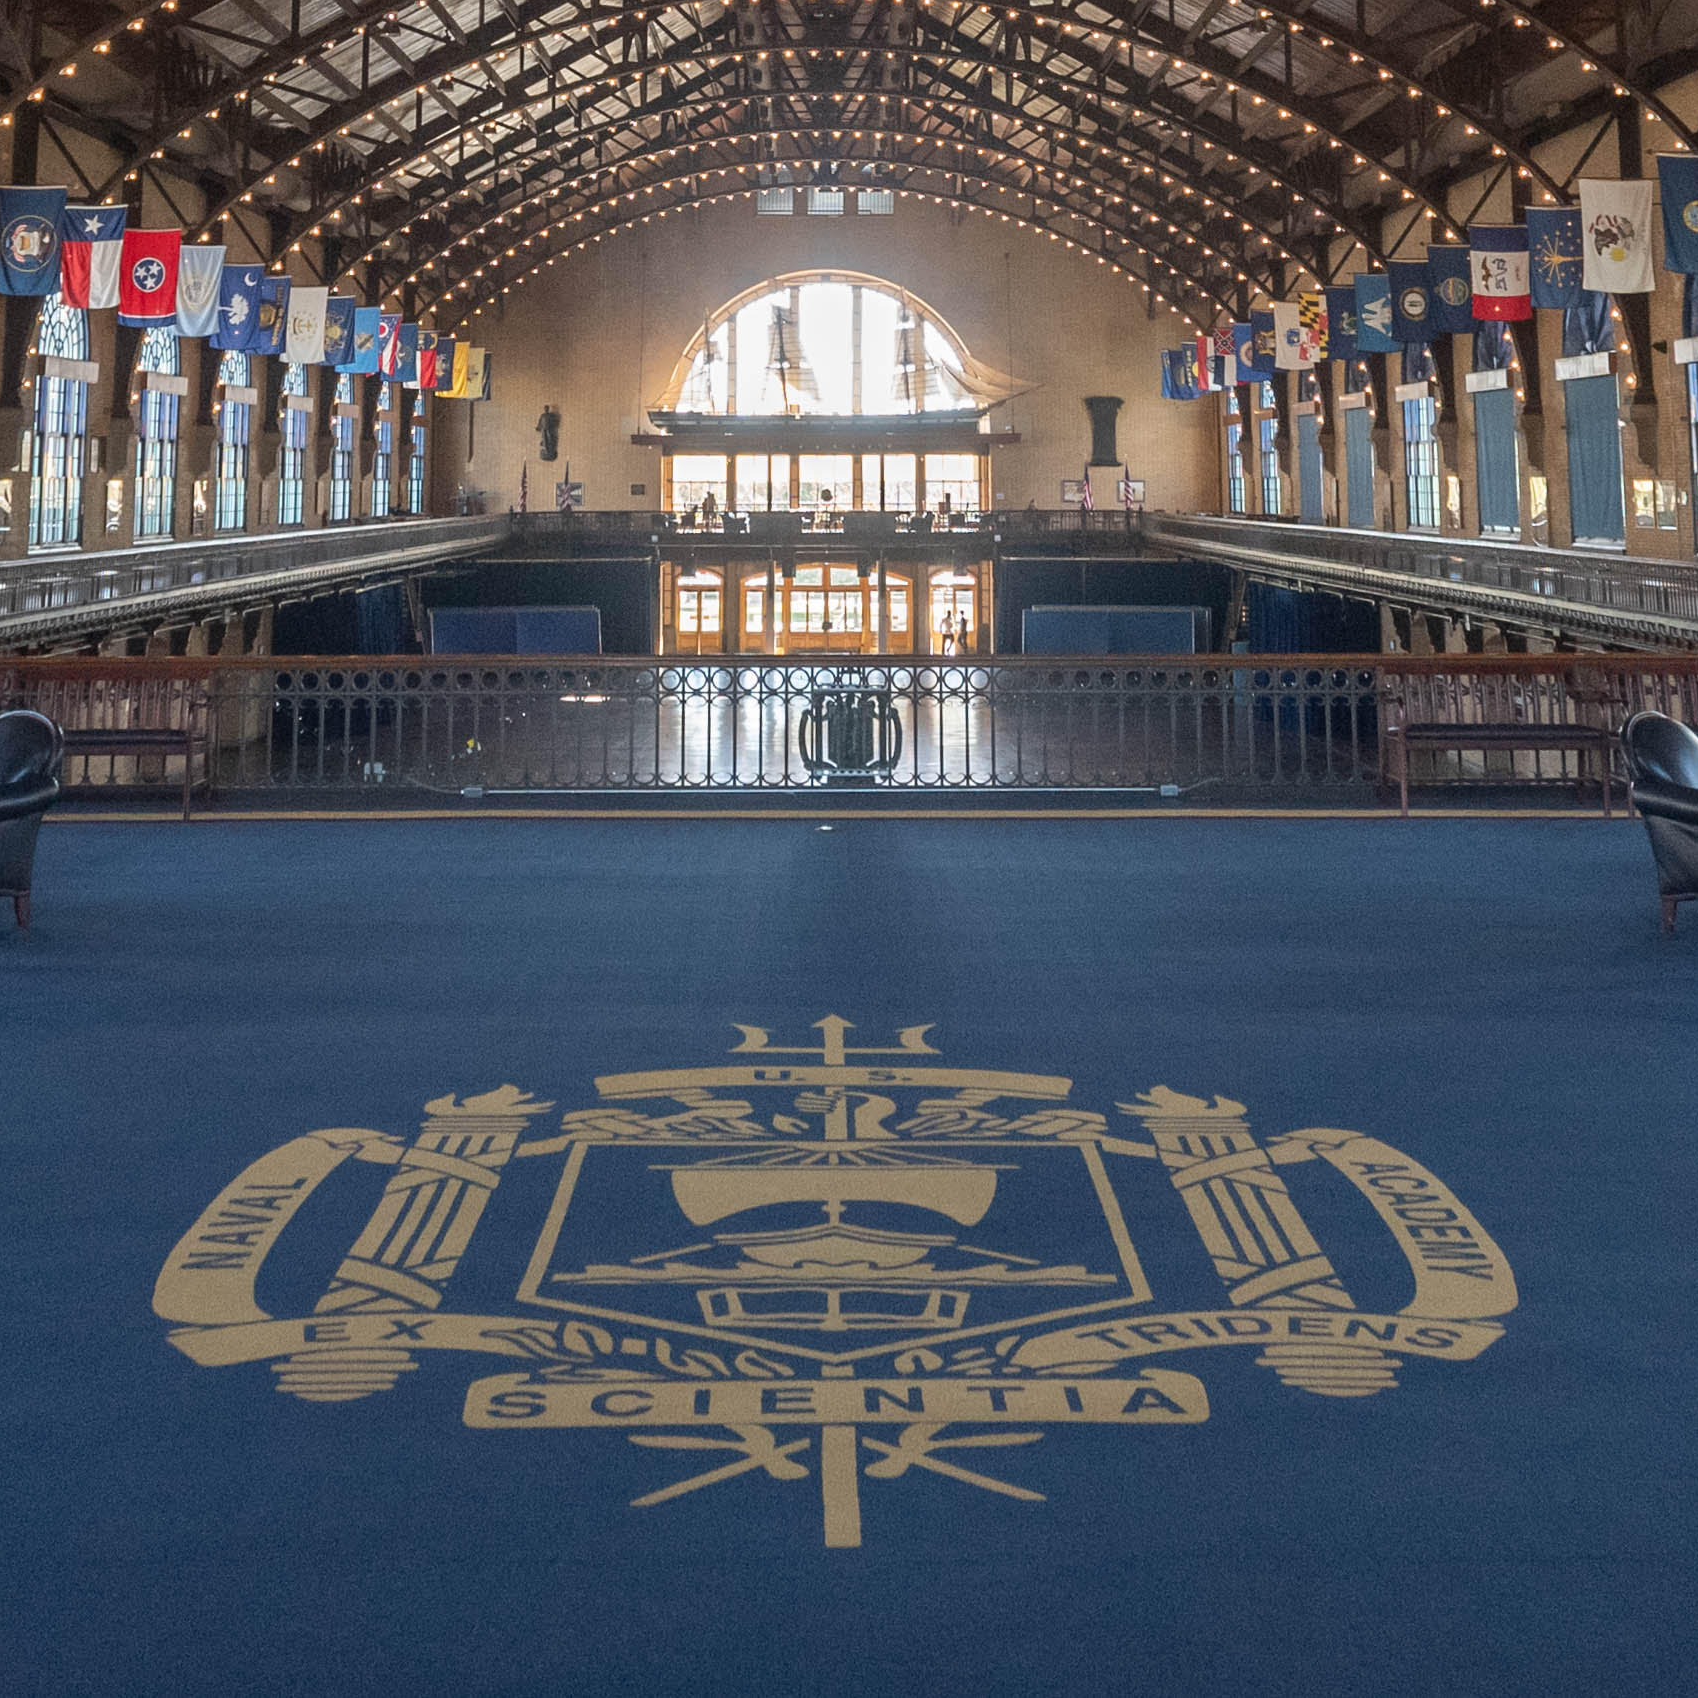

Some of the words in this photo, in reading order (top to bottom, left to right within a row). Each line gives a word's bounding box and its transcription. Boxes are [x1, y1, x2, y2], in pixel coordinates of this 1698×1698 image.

[179, 1177, 308, 1270] NAVAL
[1349, 1160, 1494, 1281] ACADEMY
[303, 1319, 435, 1343] EX
[1075, 1315, 1463, 1350] TRIDENS
[489, 1386, 1189, 1419] SCIENTIA
